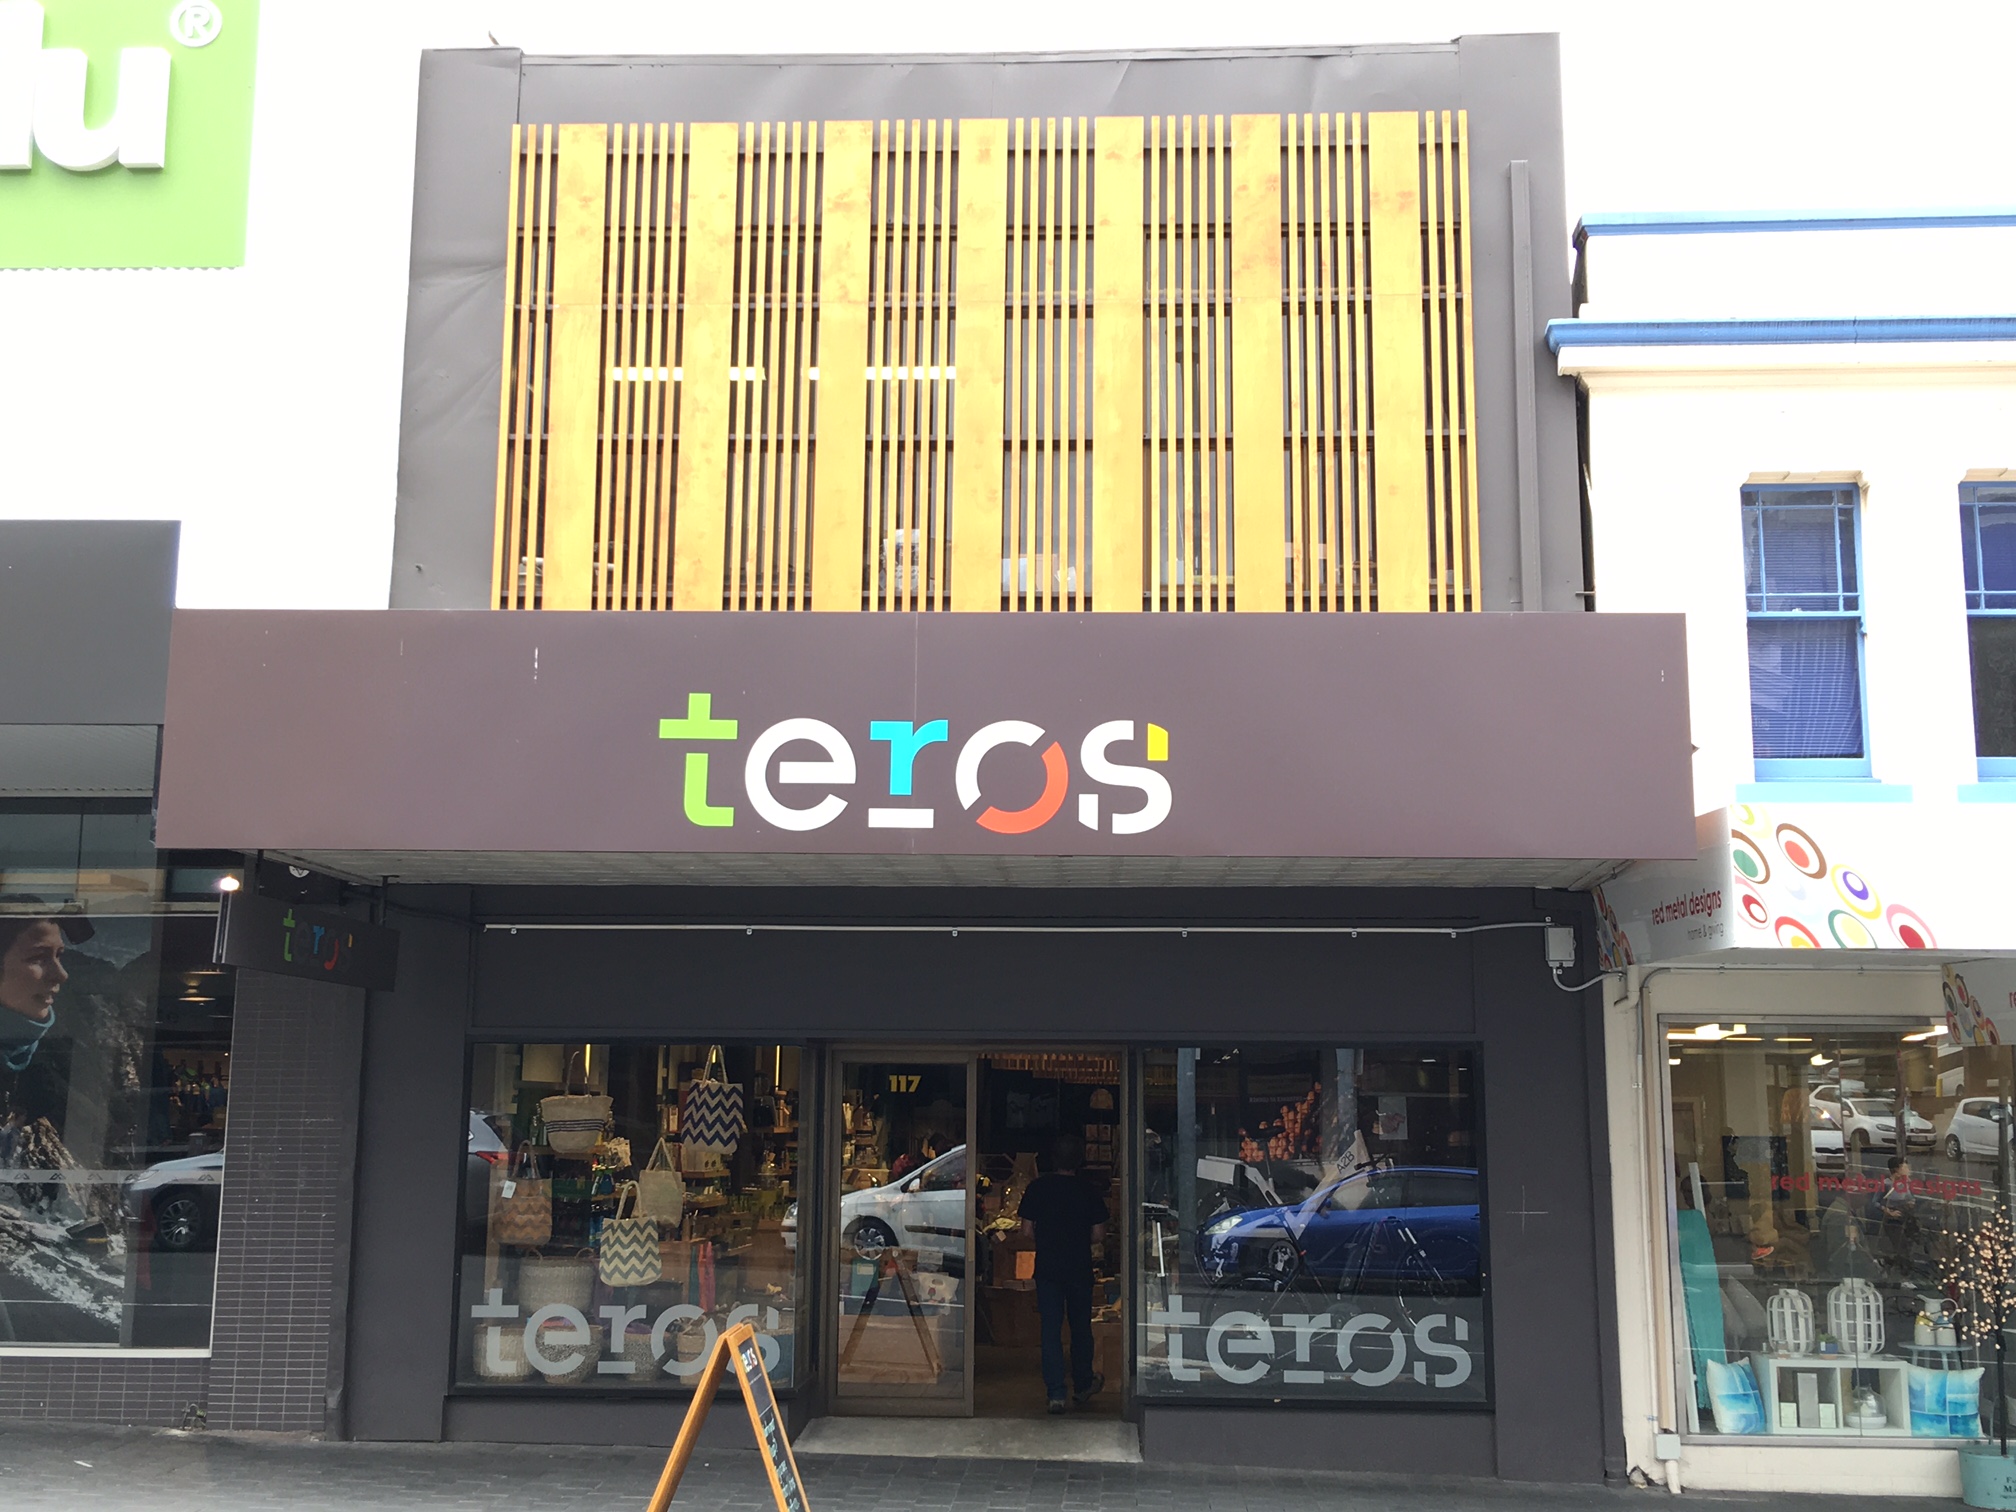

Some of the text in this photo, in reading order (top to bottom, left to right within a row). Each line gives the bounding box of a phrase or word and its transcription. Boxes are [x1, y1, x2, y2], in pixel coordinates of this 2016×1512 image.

[658, 692, 1173, 835] teros
[1651, 888, 1722, 925] red metal designs
[888, 1075, 922, 1093] 117
[1336, 1150, 1355, 1175] A2B
[1771, 1172, 1983, 1200] red metal designs
[470, 1287, 781, 1377] teros
[1151, 1294, 1473, 1388] teros
